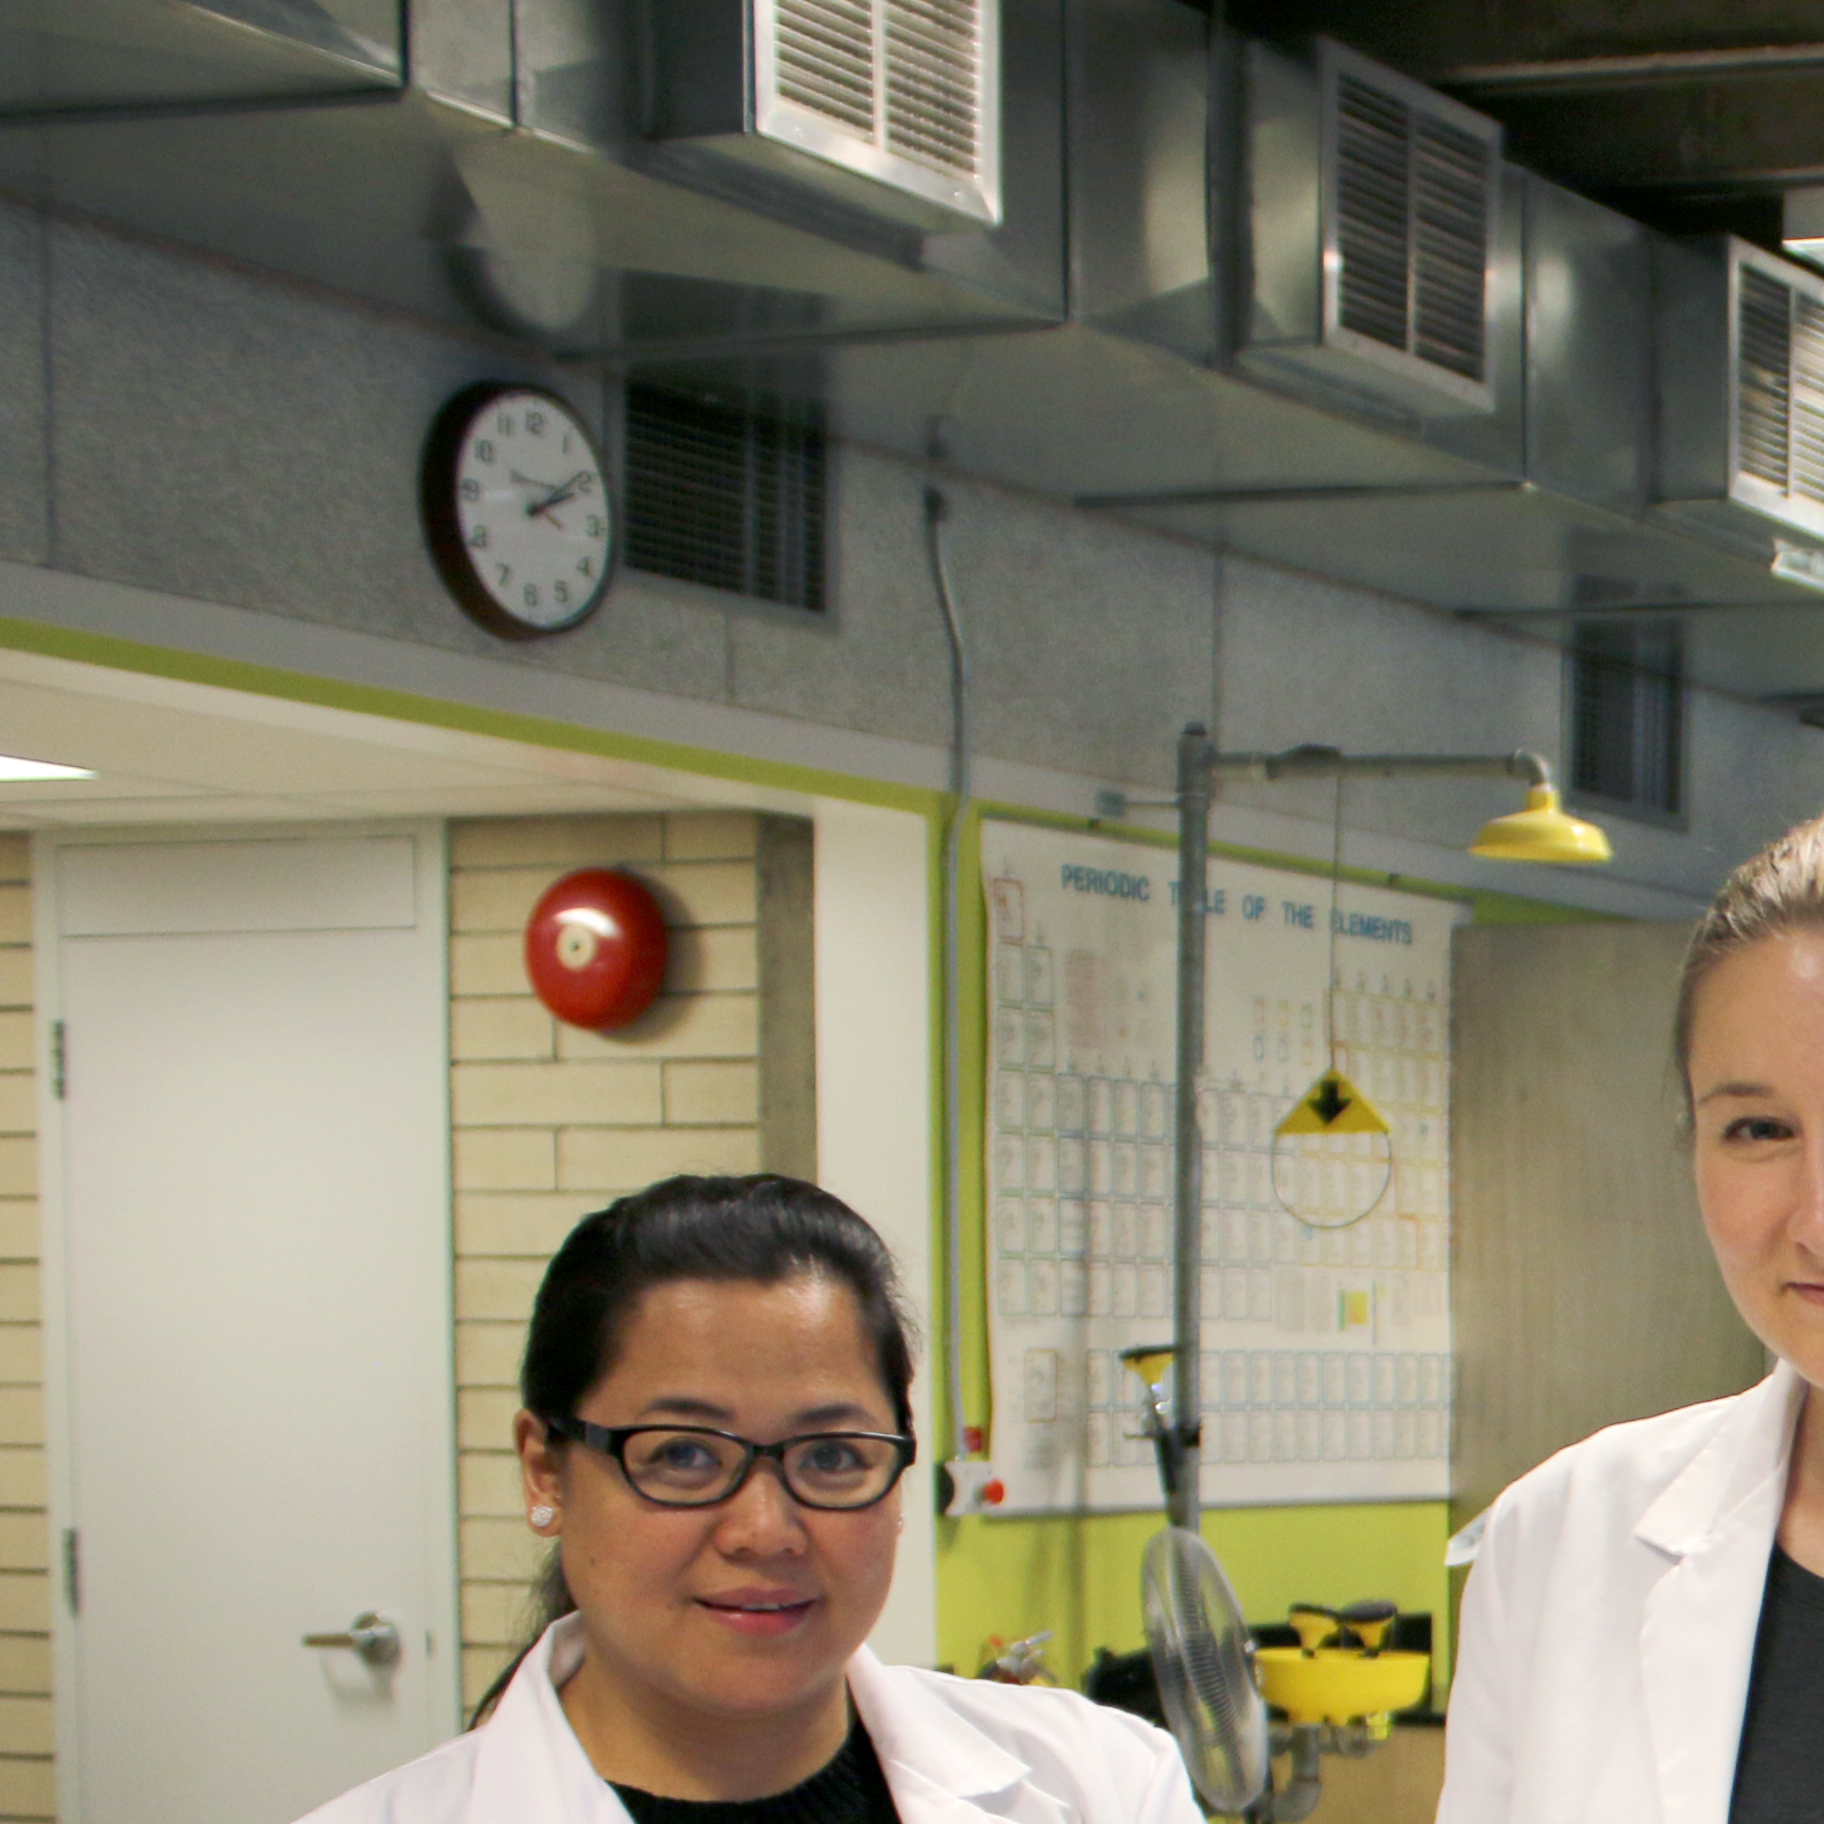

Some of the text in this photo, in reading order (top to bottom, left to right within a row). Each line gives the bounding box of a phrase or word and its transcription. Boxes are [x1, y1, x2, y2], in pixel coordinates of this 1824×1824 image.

[1061, 863, 1412, 945] PERIODIC TLE OF THE ELEMENTS
